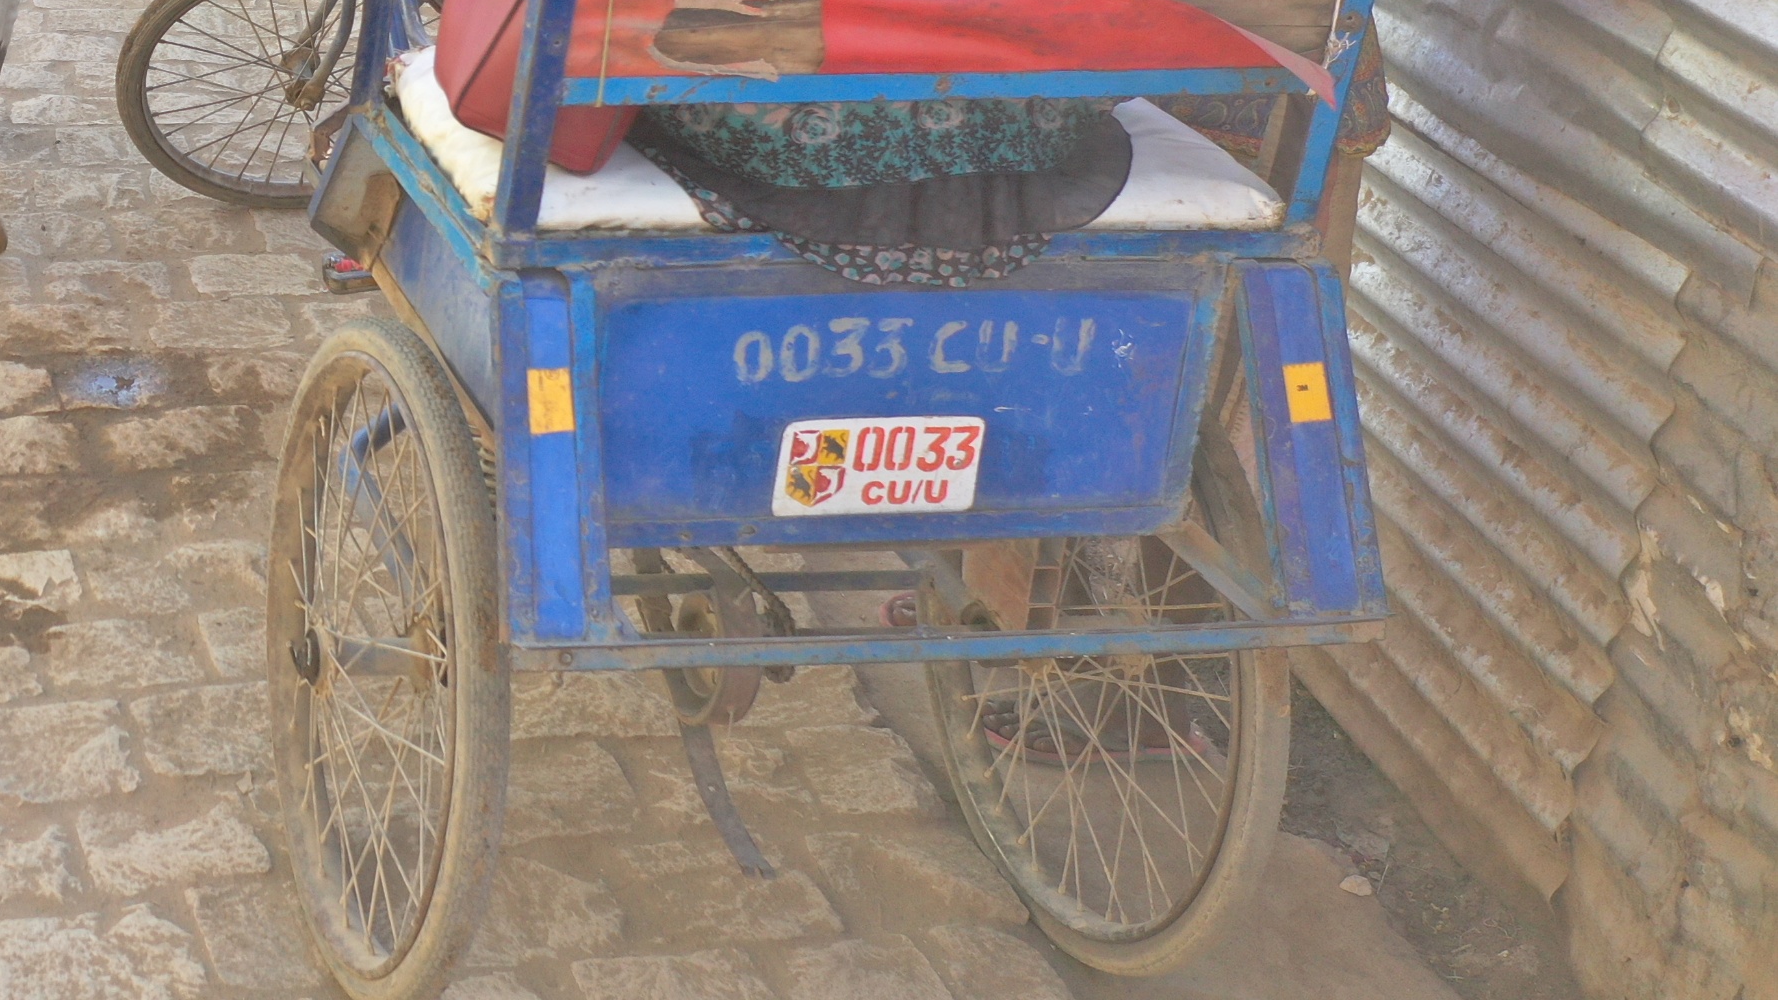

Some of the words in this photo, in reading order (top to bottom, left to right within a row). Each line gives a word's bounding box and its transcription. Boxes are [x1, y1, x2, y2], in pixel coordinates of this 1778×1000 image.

[733, 317, 914, 384] 0033
[852, 426, 980, 472] 0033
[861, 479, 948, 505] CU/U
